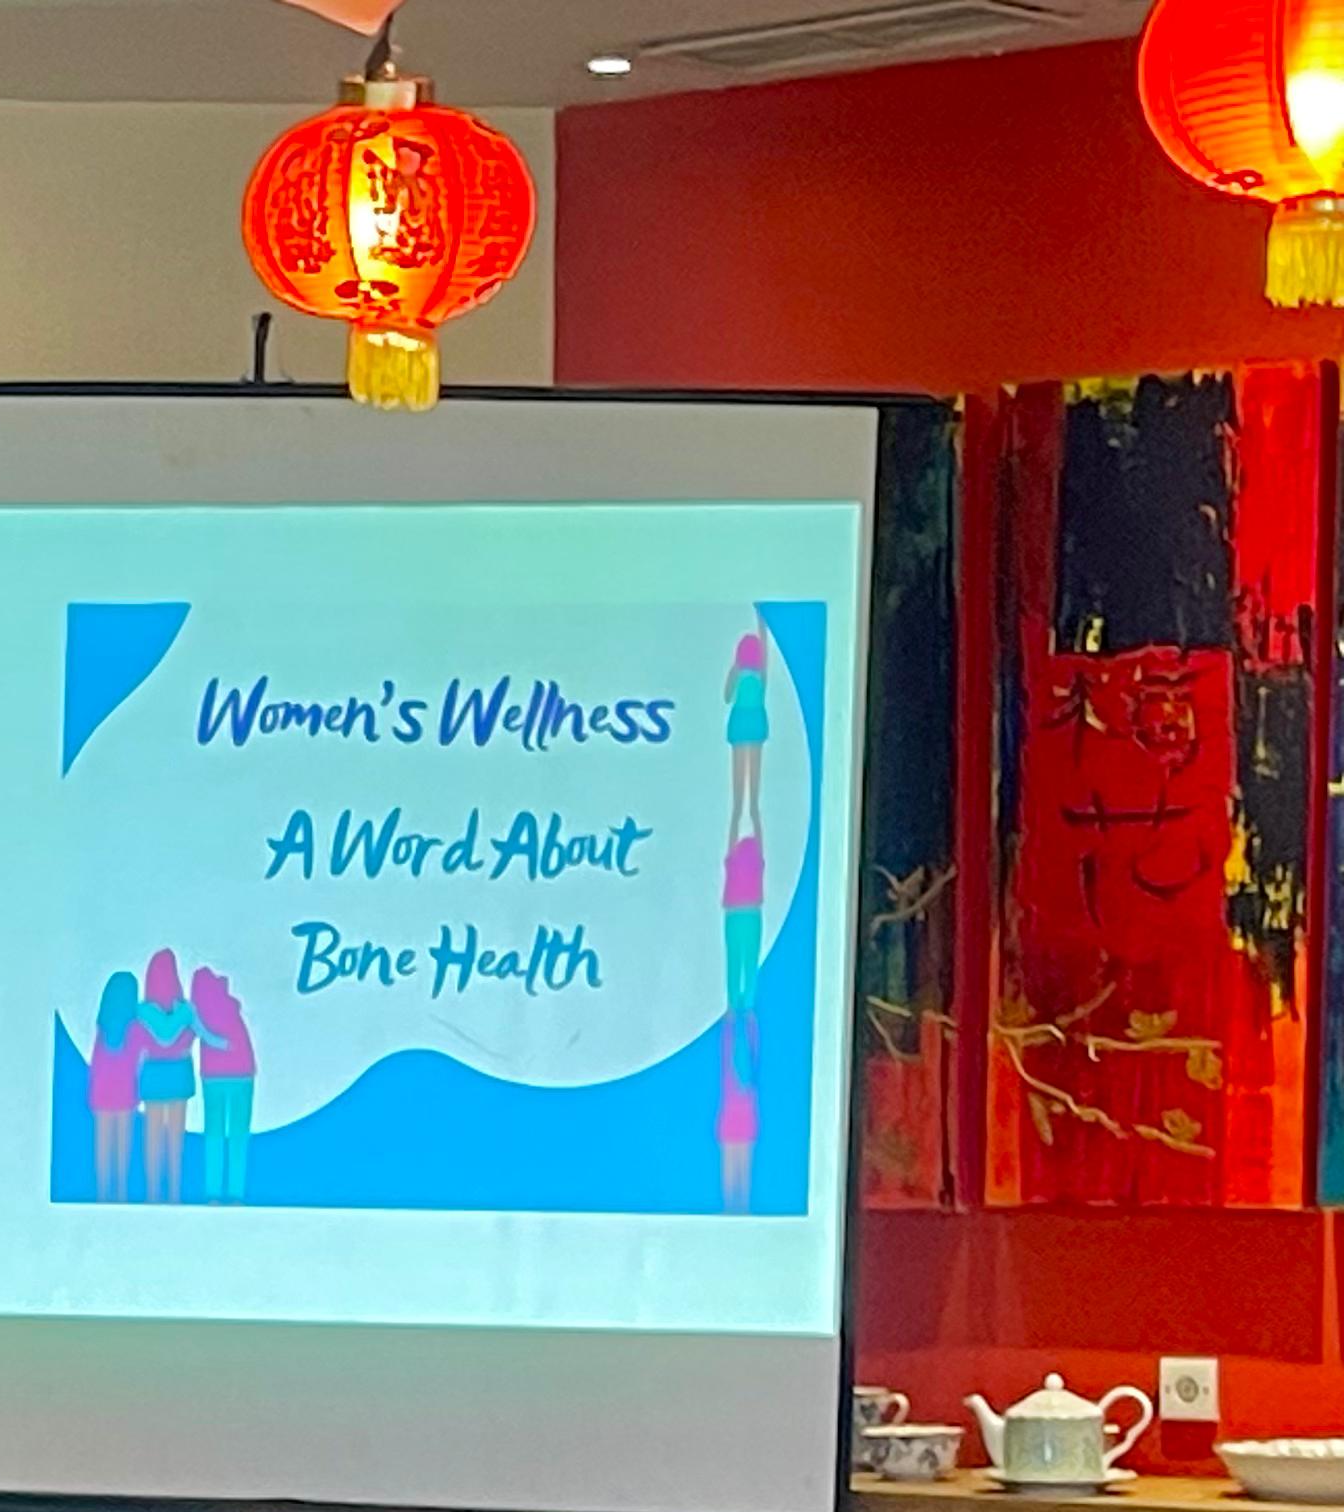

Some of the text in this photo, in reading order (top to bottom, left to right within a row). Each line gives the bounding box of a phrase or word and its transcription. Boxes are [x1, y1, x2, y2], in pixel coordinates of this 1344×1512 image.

[197, 676, 676, 752] Women's Wellness
[264, 806, 654, 882] A Word About
[290, 921, 604, 999] Bone Health
